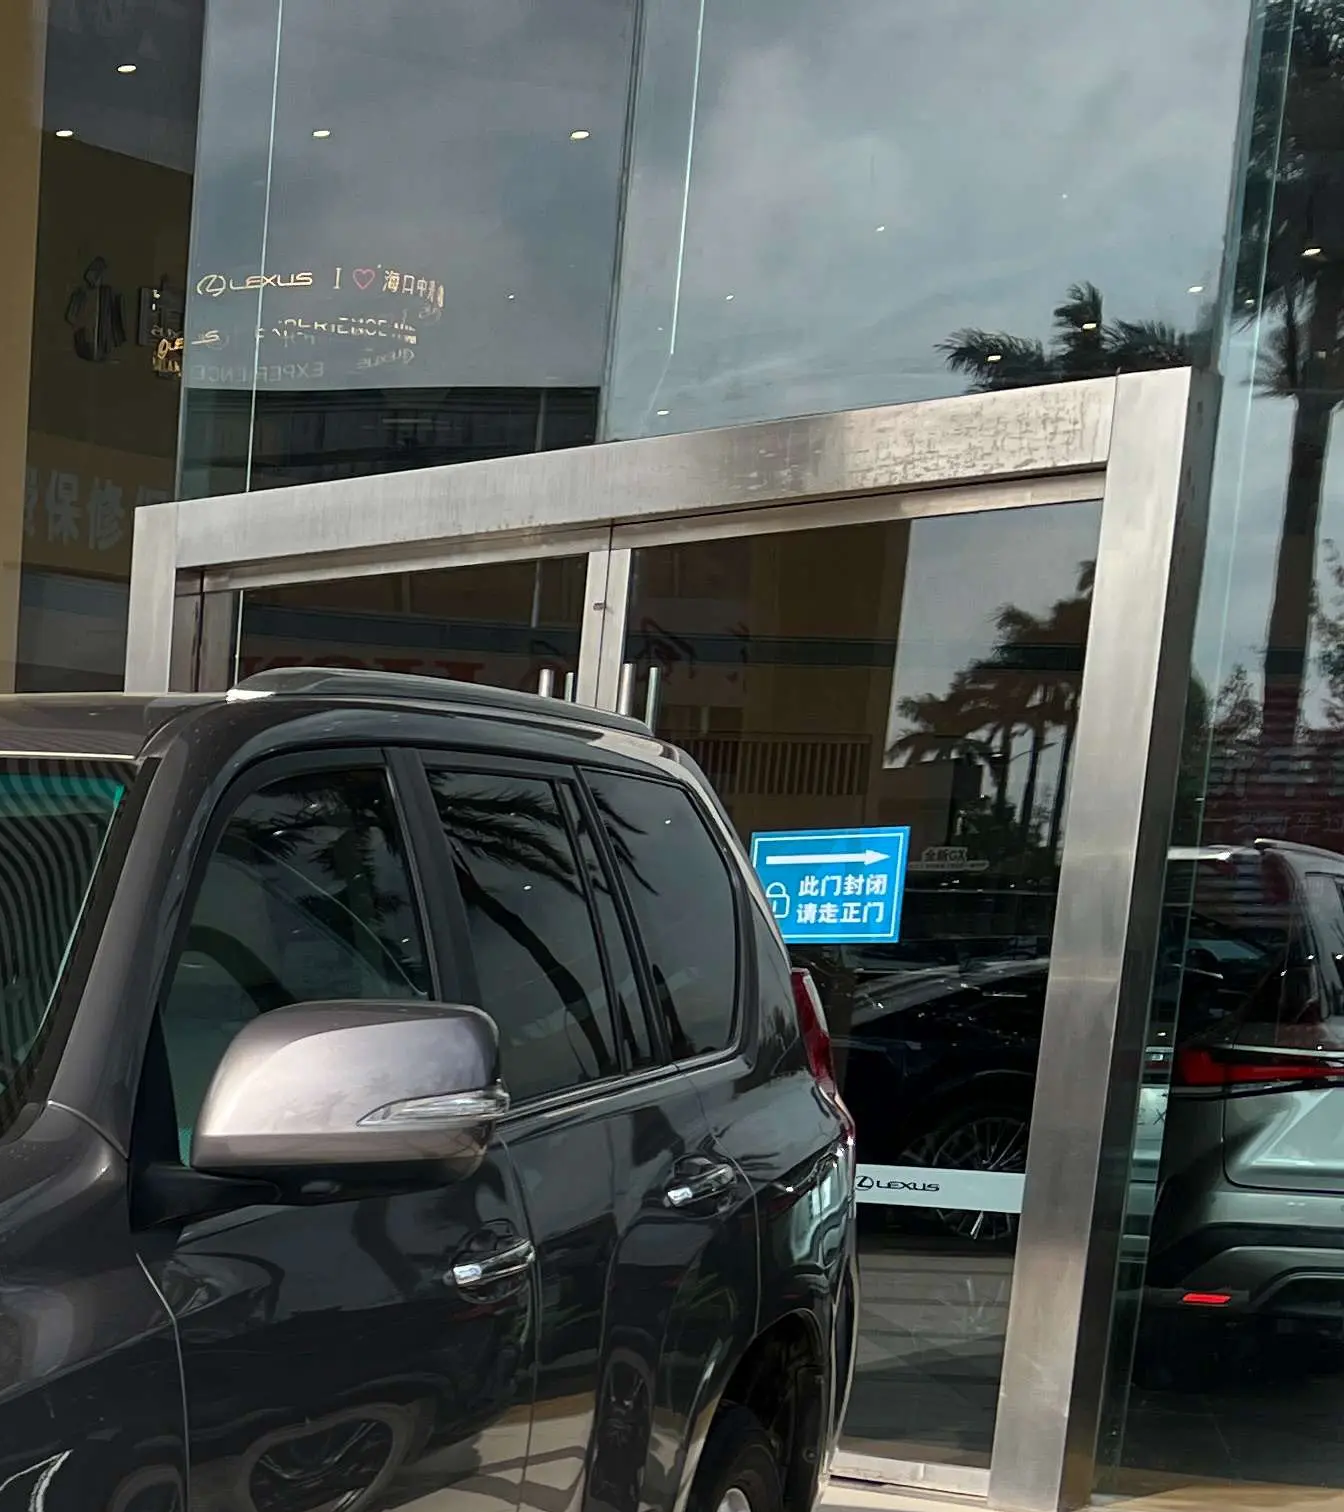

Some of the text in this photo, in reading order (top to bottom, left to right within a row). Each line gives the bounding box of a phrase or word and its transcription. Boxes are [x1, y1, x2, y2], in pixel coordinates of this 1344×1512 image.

[228, 272, 313, 290] LEXUS
[797, 873, 889, 897] 此门封闭
[796, 902, 885, 925] 请走正门
[876, 1180, 941, 1192] LEXUS
